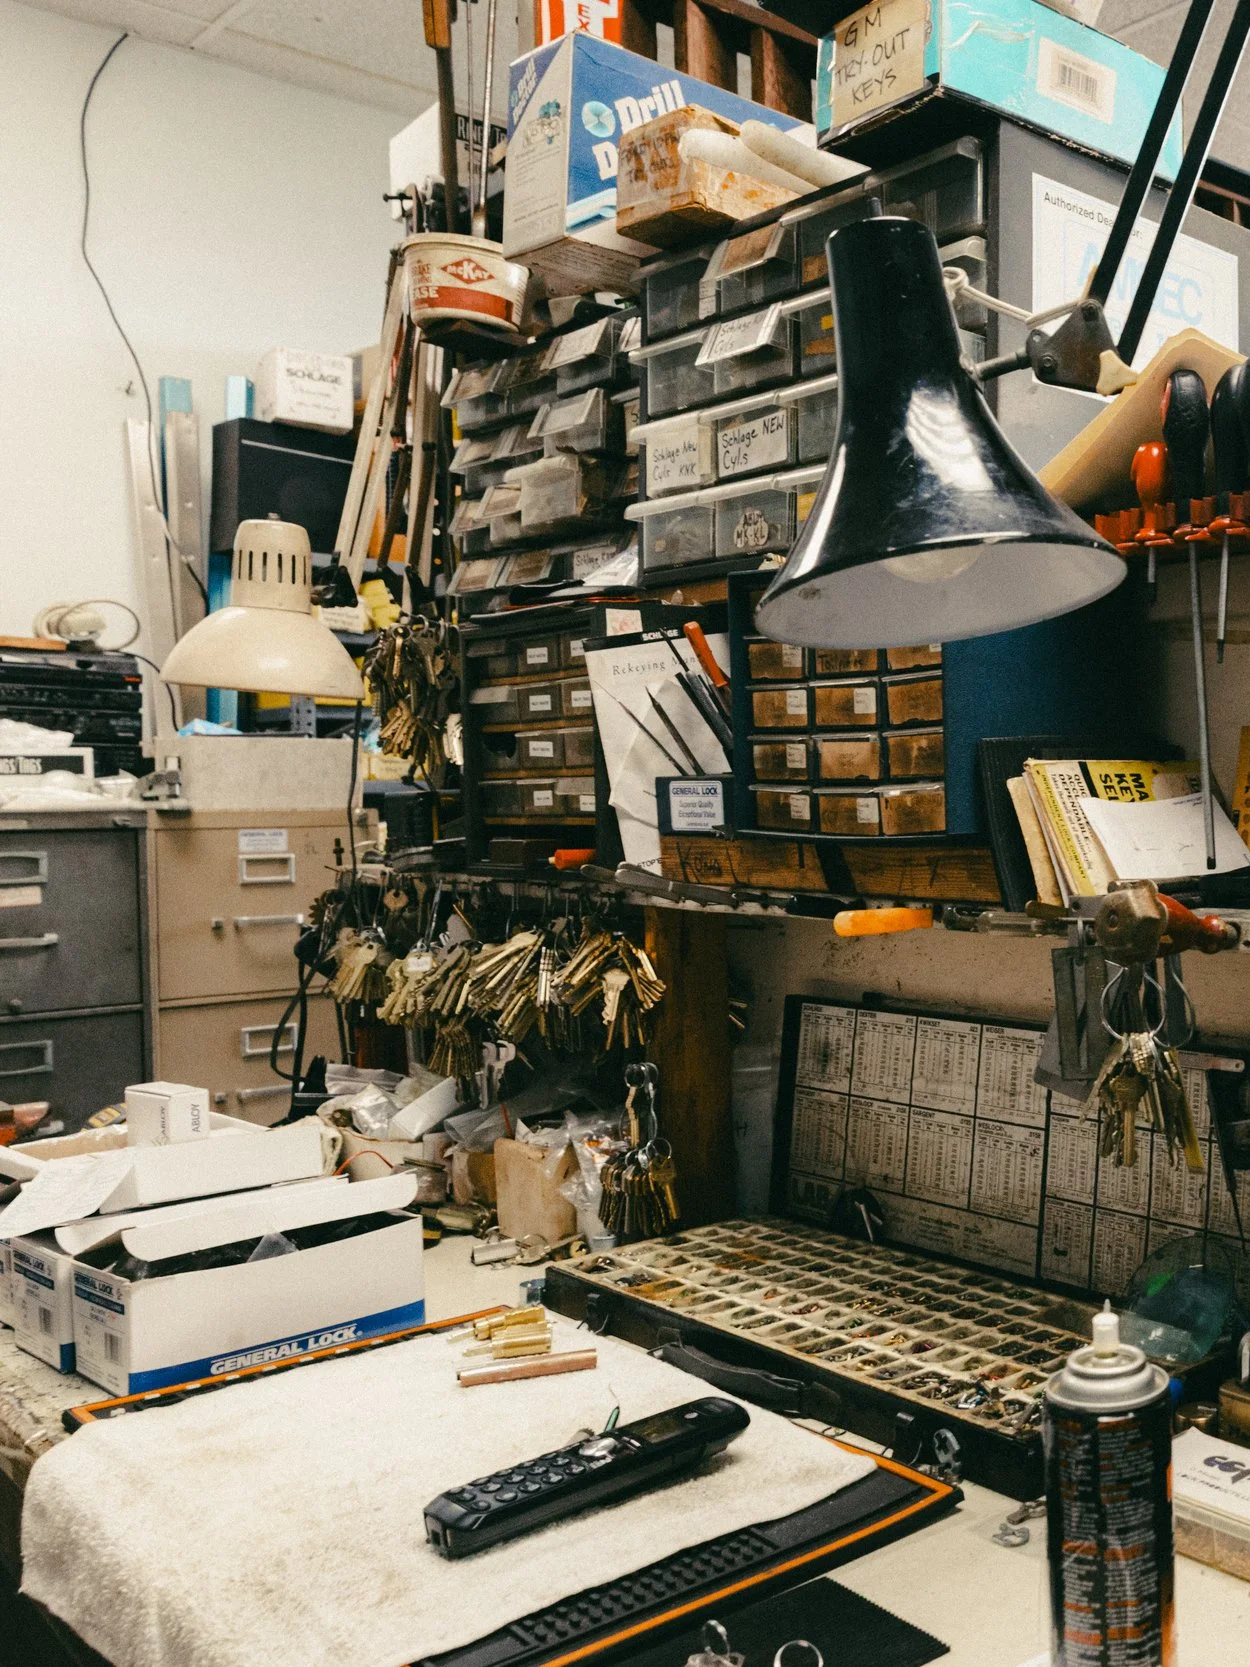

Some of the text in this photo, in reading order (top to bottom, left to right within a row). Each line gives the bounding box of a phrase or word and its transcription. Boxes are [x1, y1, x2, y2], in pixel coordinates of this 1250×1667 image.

[844, 8, 882, 47] GM
[852, 68, 897, 105] KEYS
[615, 80, 686, 135] Drill
[1044, 192, 1094, 221] Authorized
[722, 417, 784, 449] Schlage NEW
[612, 660, 667, 677] Rekeying
[672, 786, 718, 795] GENERAL LOCK
[191, 1103, 201, 1133] ABLOY
[210, 1326, 358, 1376] GENERAL LOCK
